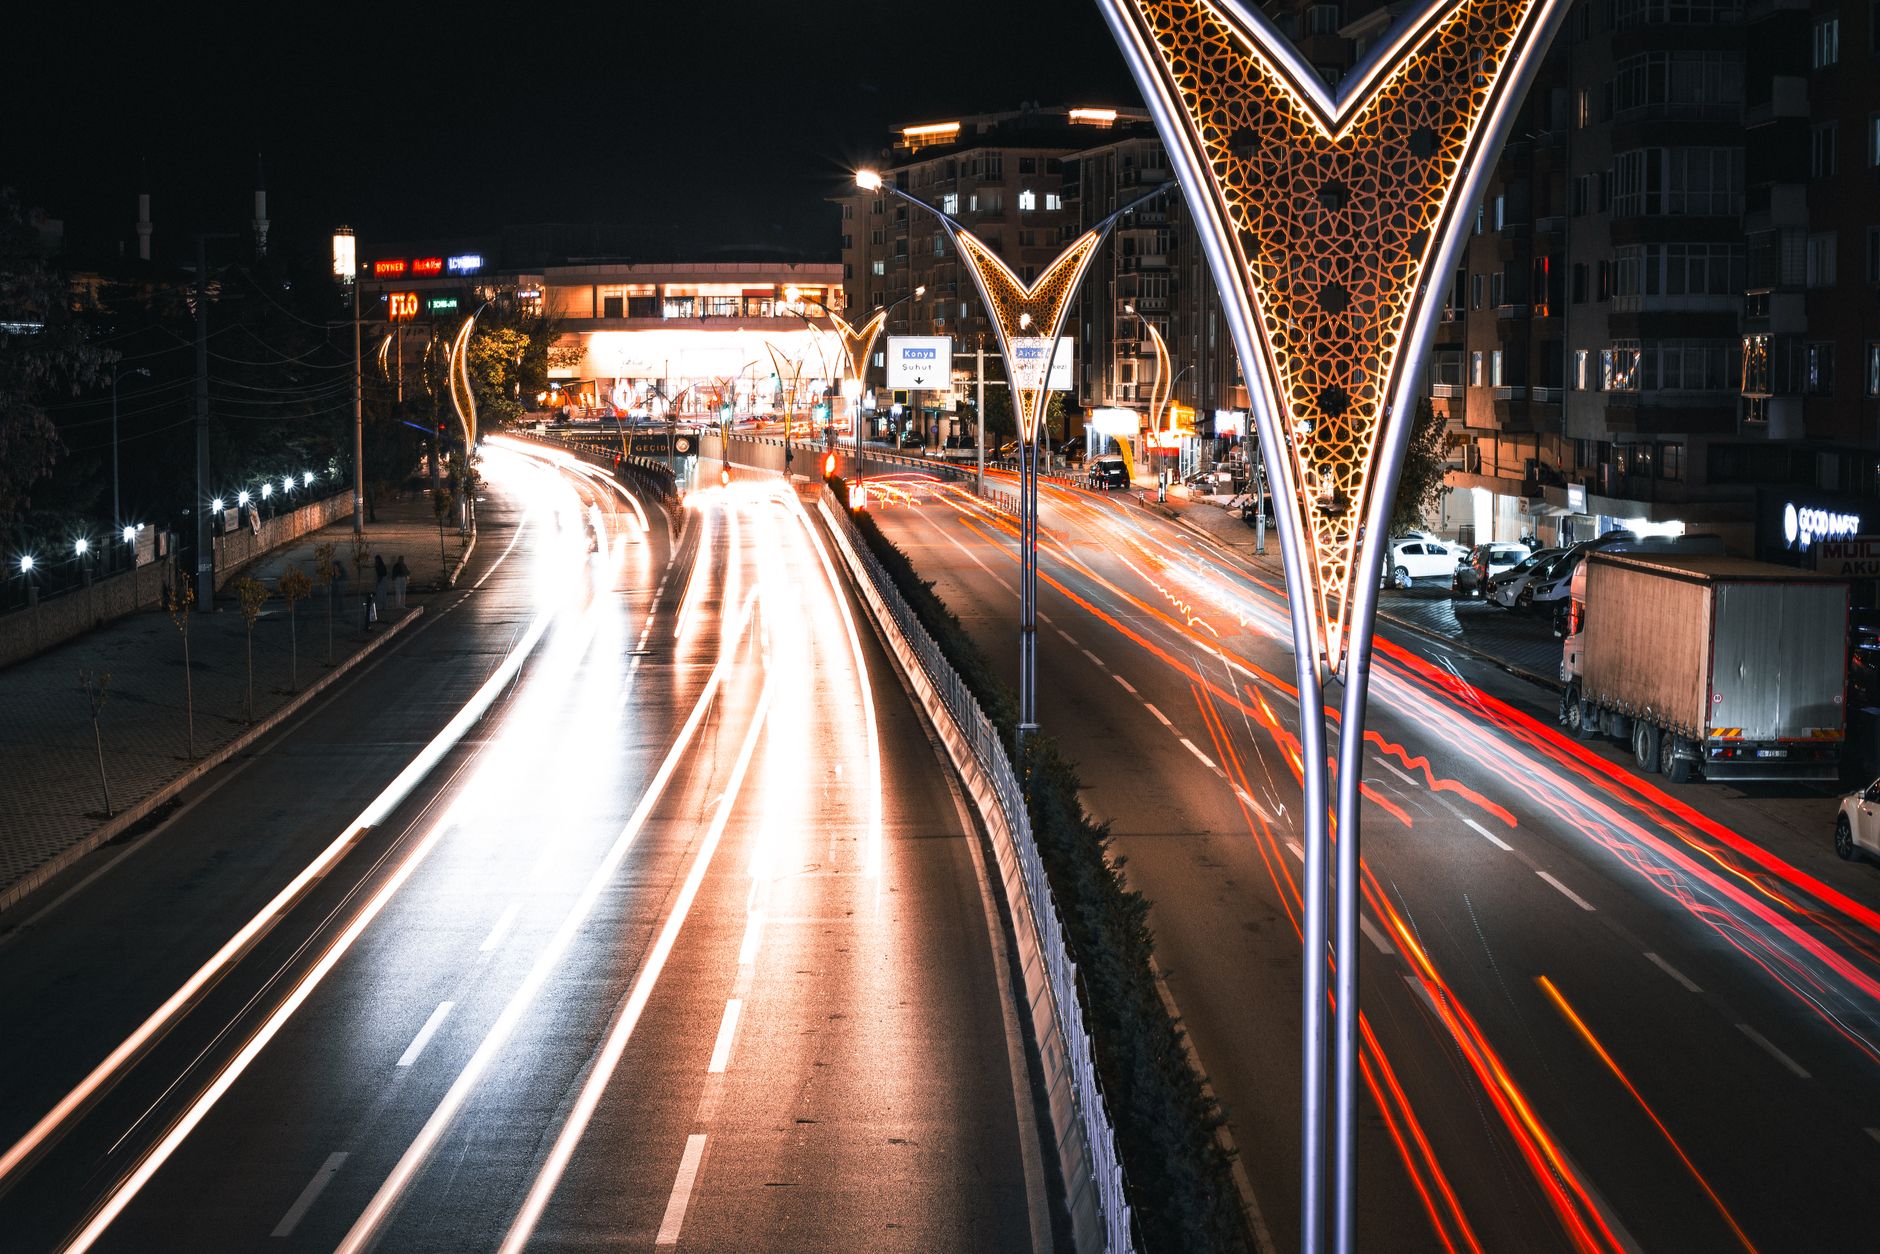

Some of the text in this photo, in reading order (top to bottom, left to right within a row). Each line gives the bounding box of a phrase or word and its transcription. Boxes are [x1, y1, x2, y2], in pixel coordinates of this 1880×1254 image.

[376, 262, 404, 273] BOYNER
[391, 294, 418, 316] FLO
[904, 350, 934, 359] Konya
[902, 363, 932, 371] Şuhut
[1799, 507, 1828, 536] GOOD
